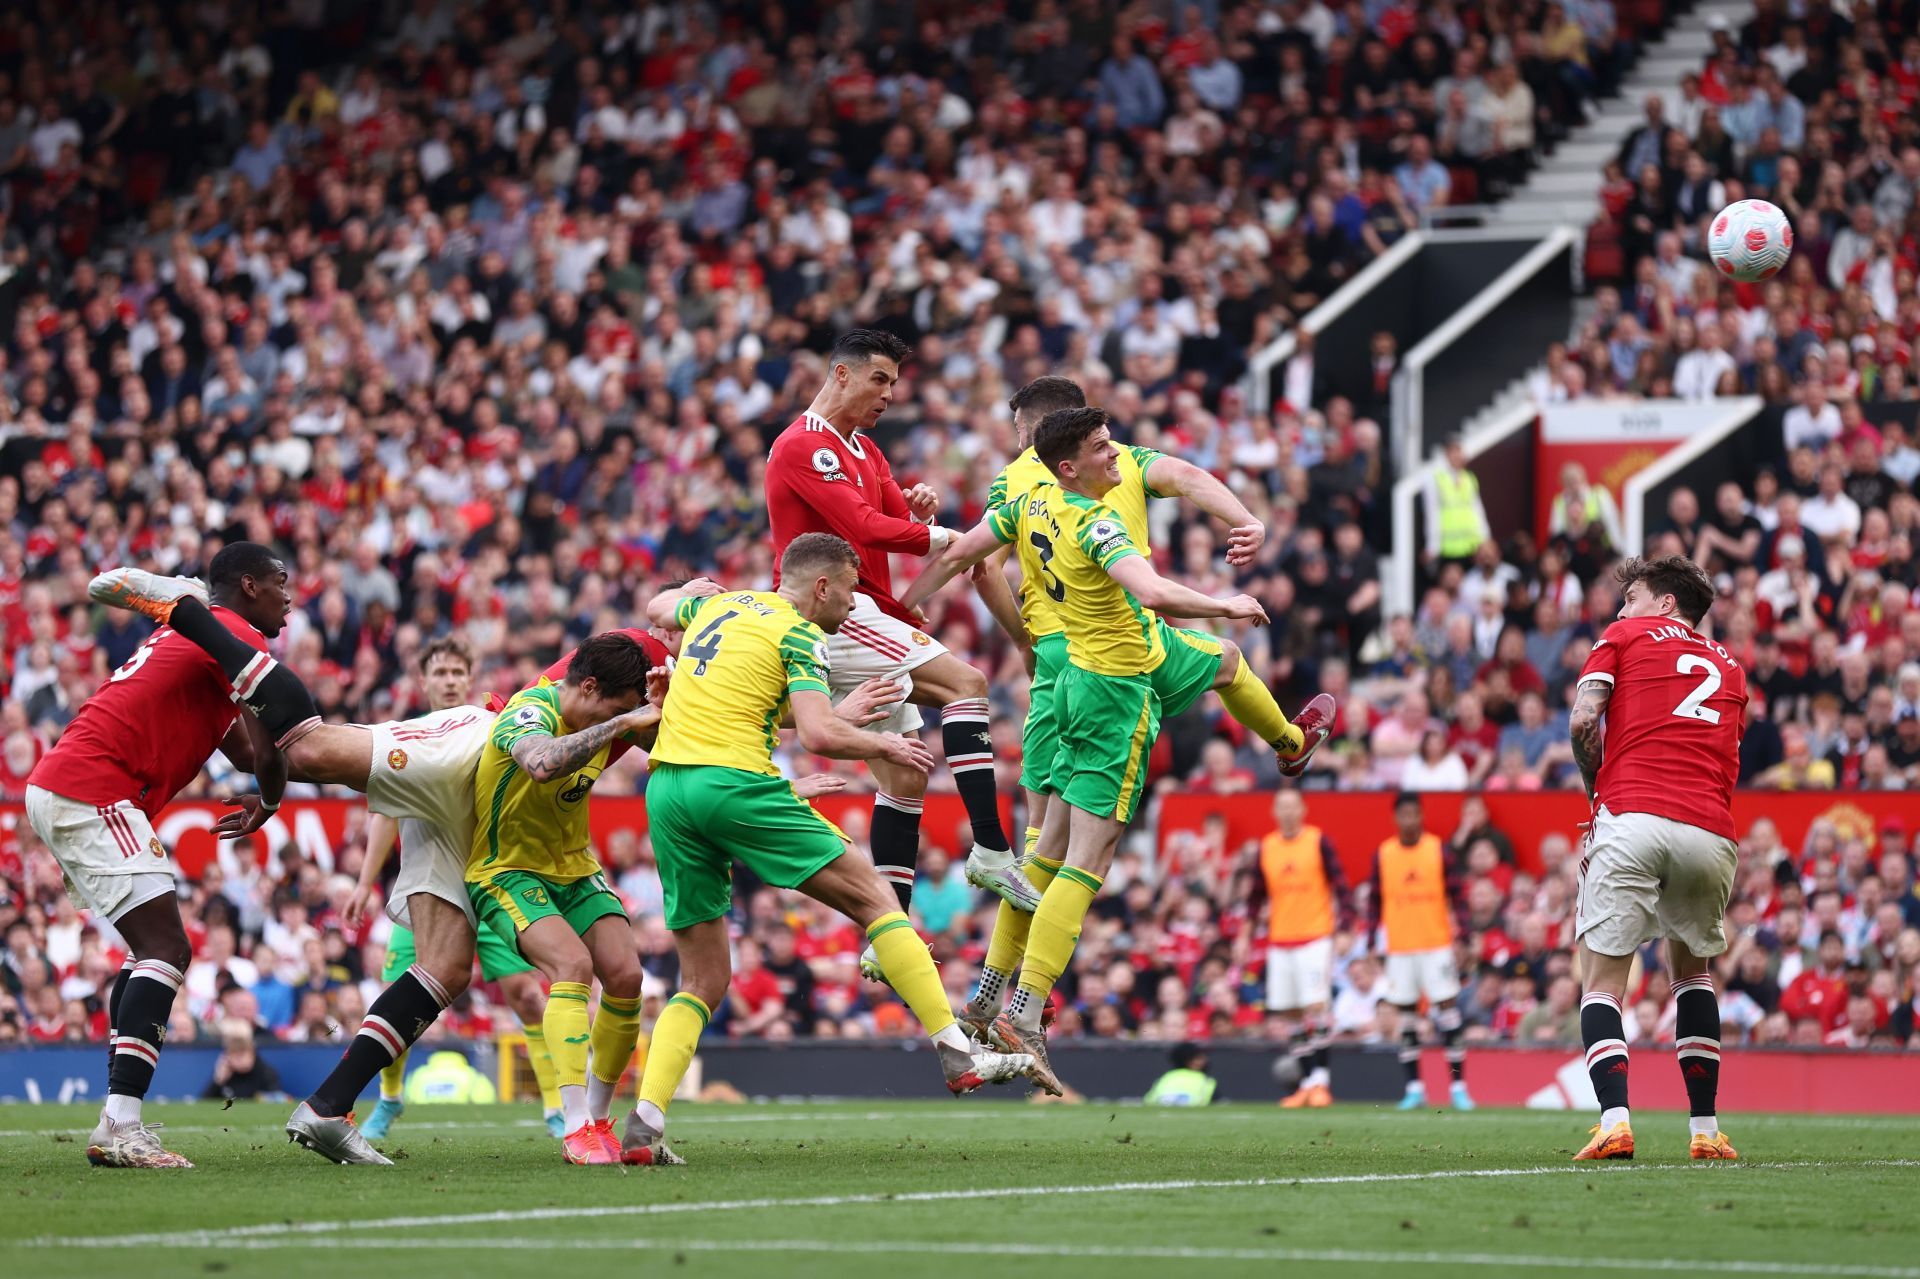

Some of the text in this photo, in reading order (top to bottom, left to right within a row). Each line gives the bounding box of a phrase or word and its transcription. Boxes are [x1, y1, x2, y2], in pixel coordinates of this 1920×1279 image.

[1030, 531, 1066, 603] 3
[682, 610, 739, 676] 4
[1671, 653, 1722, 725] 2
